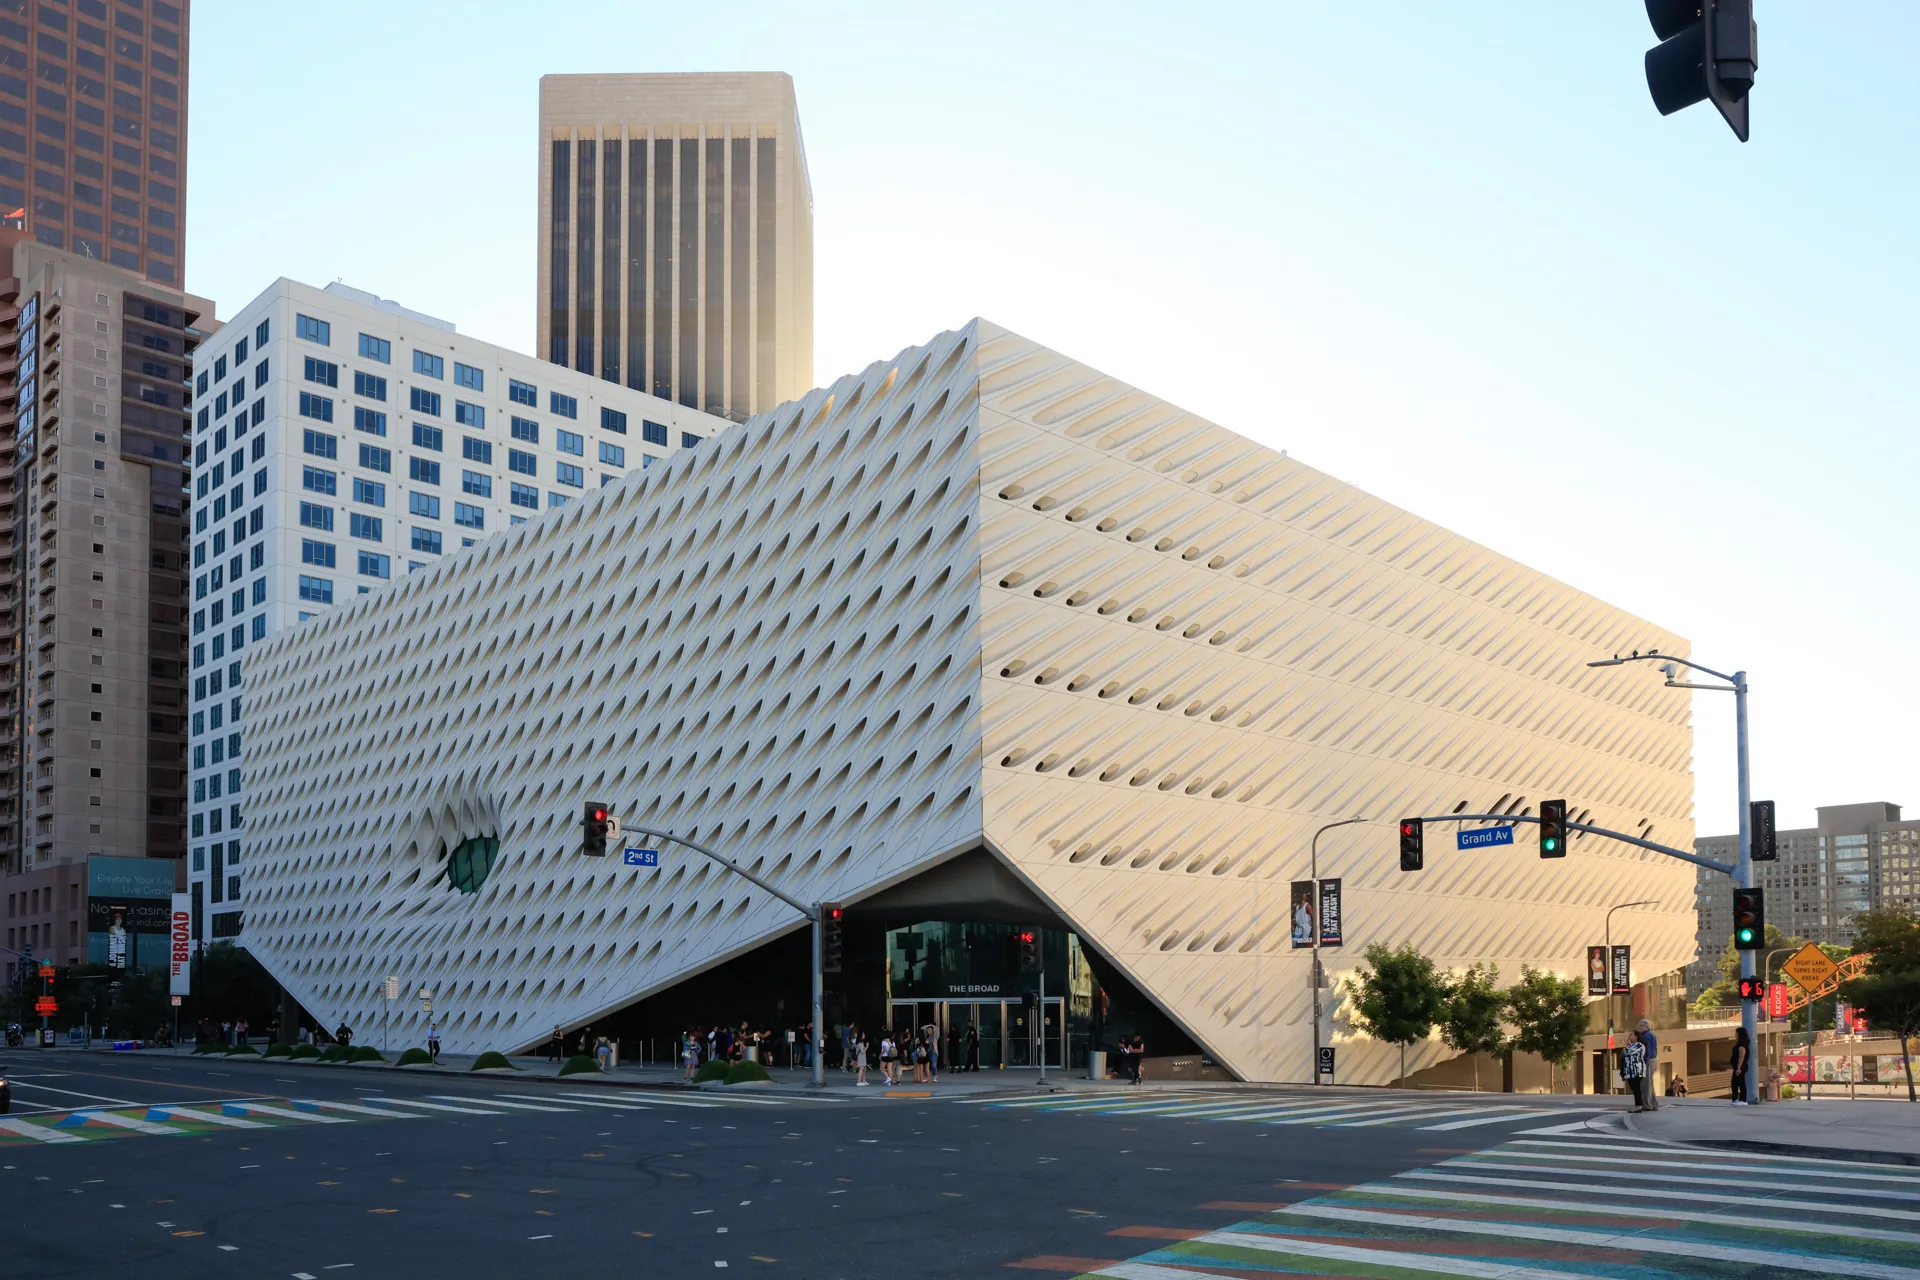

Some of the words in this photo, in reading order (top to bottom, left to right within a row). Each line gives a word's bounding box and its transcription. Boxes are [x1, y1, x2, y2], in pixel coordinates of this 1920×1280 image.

[1462, 831, 1492, 845] Grand
[1495, 830, 1508, 841] Av
[627, 851, 643, 863] 2nd
[645, 853, 654, 863] St
[97, 873, 132, 884] Elevate
[134, 875, 154, 885] Your
[157, 877, 173, 886] Life
[122, 886, 141, 894] Live
[143, 886, 173, 897] Grand
[1330, 919, 1338, 933] THAT
[172, 911, 190, 962] BROAD
[172, 962, 181, 976] THE
[948, 984, 967, 993] THE
[968, 984, 1000, 993] BROAD
[1755, 981, 1763, 995] 6
